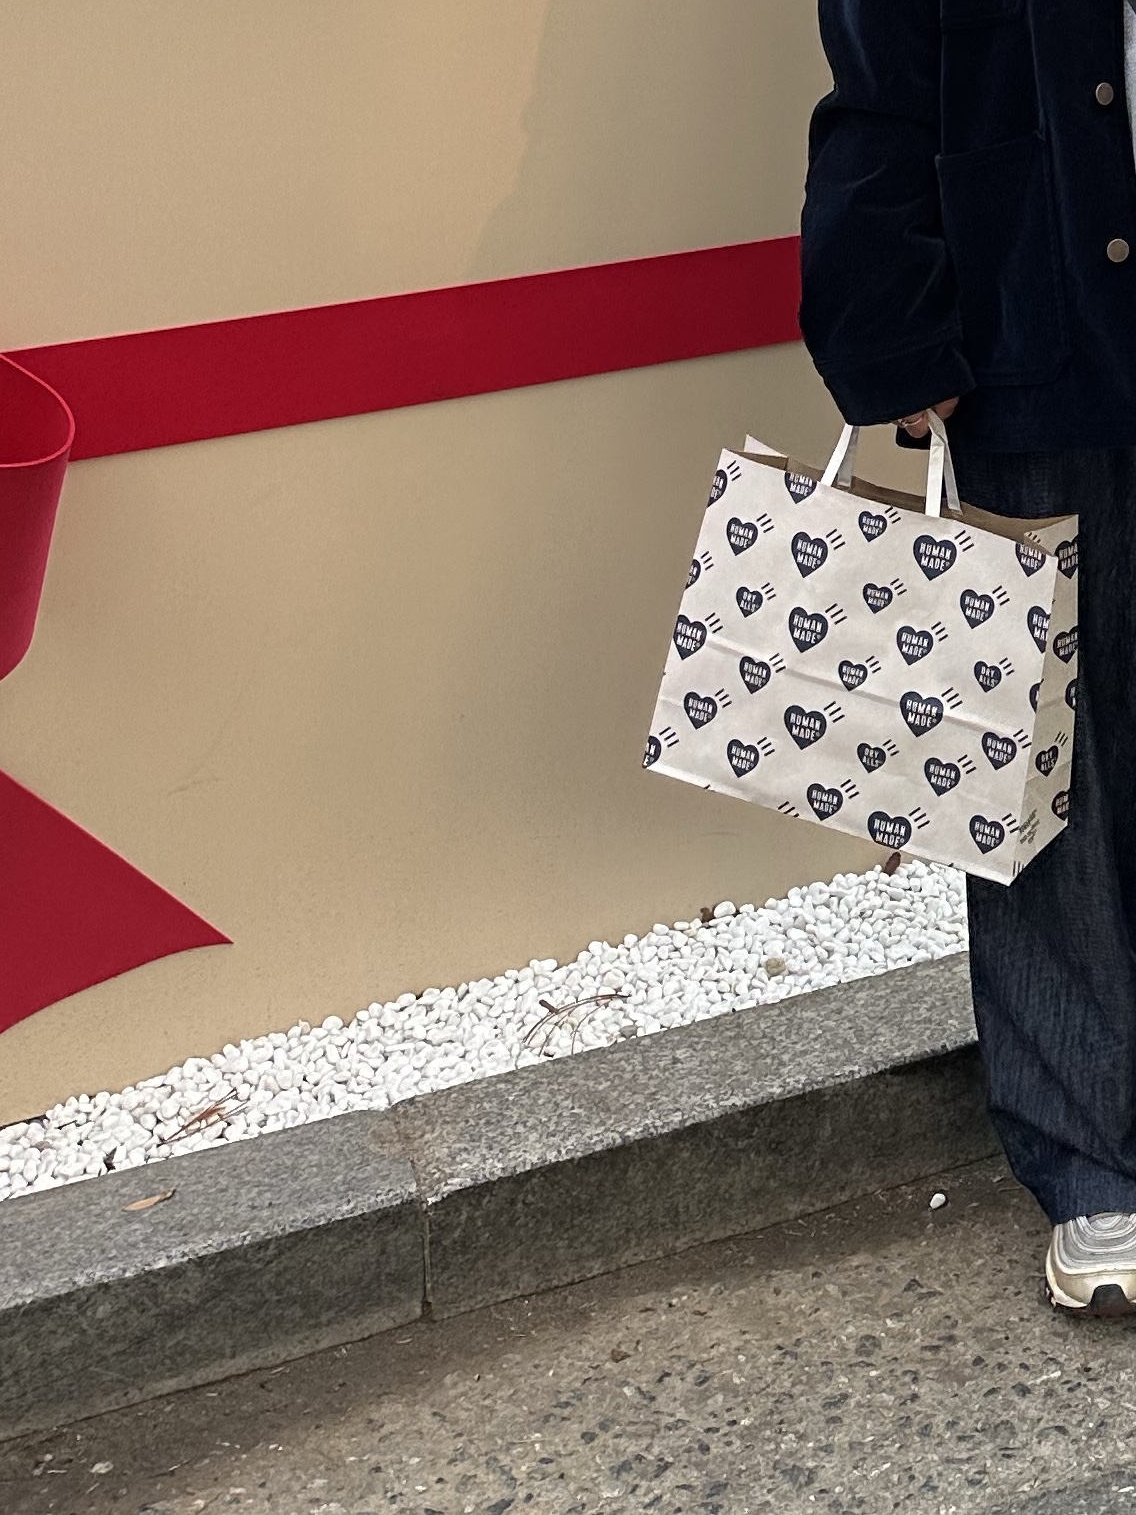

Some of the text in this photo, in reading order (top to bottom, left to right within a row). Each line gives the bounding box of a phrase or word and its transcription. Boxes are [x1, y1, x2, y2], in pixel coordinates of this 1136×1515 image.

[862, 516, 884, 528] HUMAN
[730, 523, 754, 539] HUMAN
[797, 539, 822, 559] HUMAN
[920, 542, 952, 559] HUMAN
[866, 588, 889, 599] HUMAN
[965, 596, 990, 611] HUMAN
[677, 622, 702, 641] HUMAN
[793, 614, 823, 633] HUMAN
[901, 633, 929, 647] HUMAN
[743, 662, 767, 678] HUMAN
[842, 665, 864, 677] HUMAN
[688, 697, 713, 714] HUMAN
[906, 699, 938, 718] HUMAN
[790, 713, 821, 730] HUMAN
[731, 745, 755, 761] HUMAN
[987, 737, 1012, 754] HUMAN
[929, 764, 956, 779] HUMAN
[811, 790, 839, 805] HUMAN
[874, 819, 906, 836] HUMAN
[974, 821, 1000, 838] HUMAN
